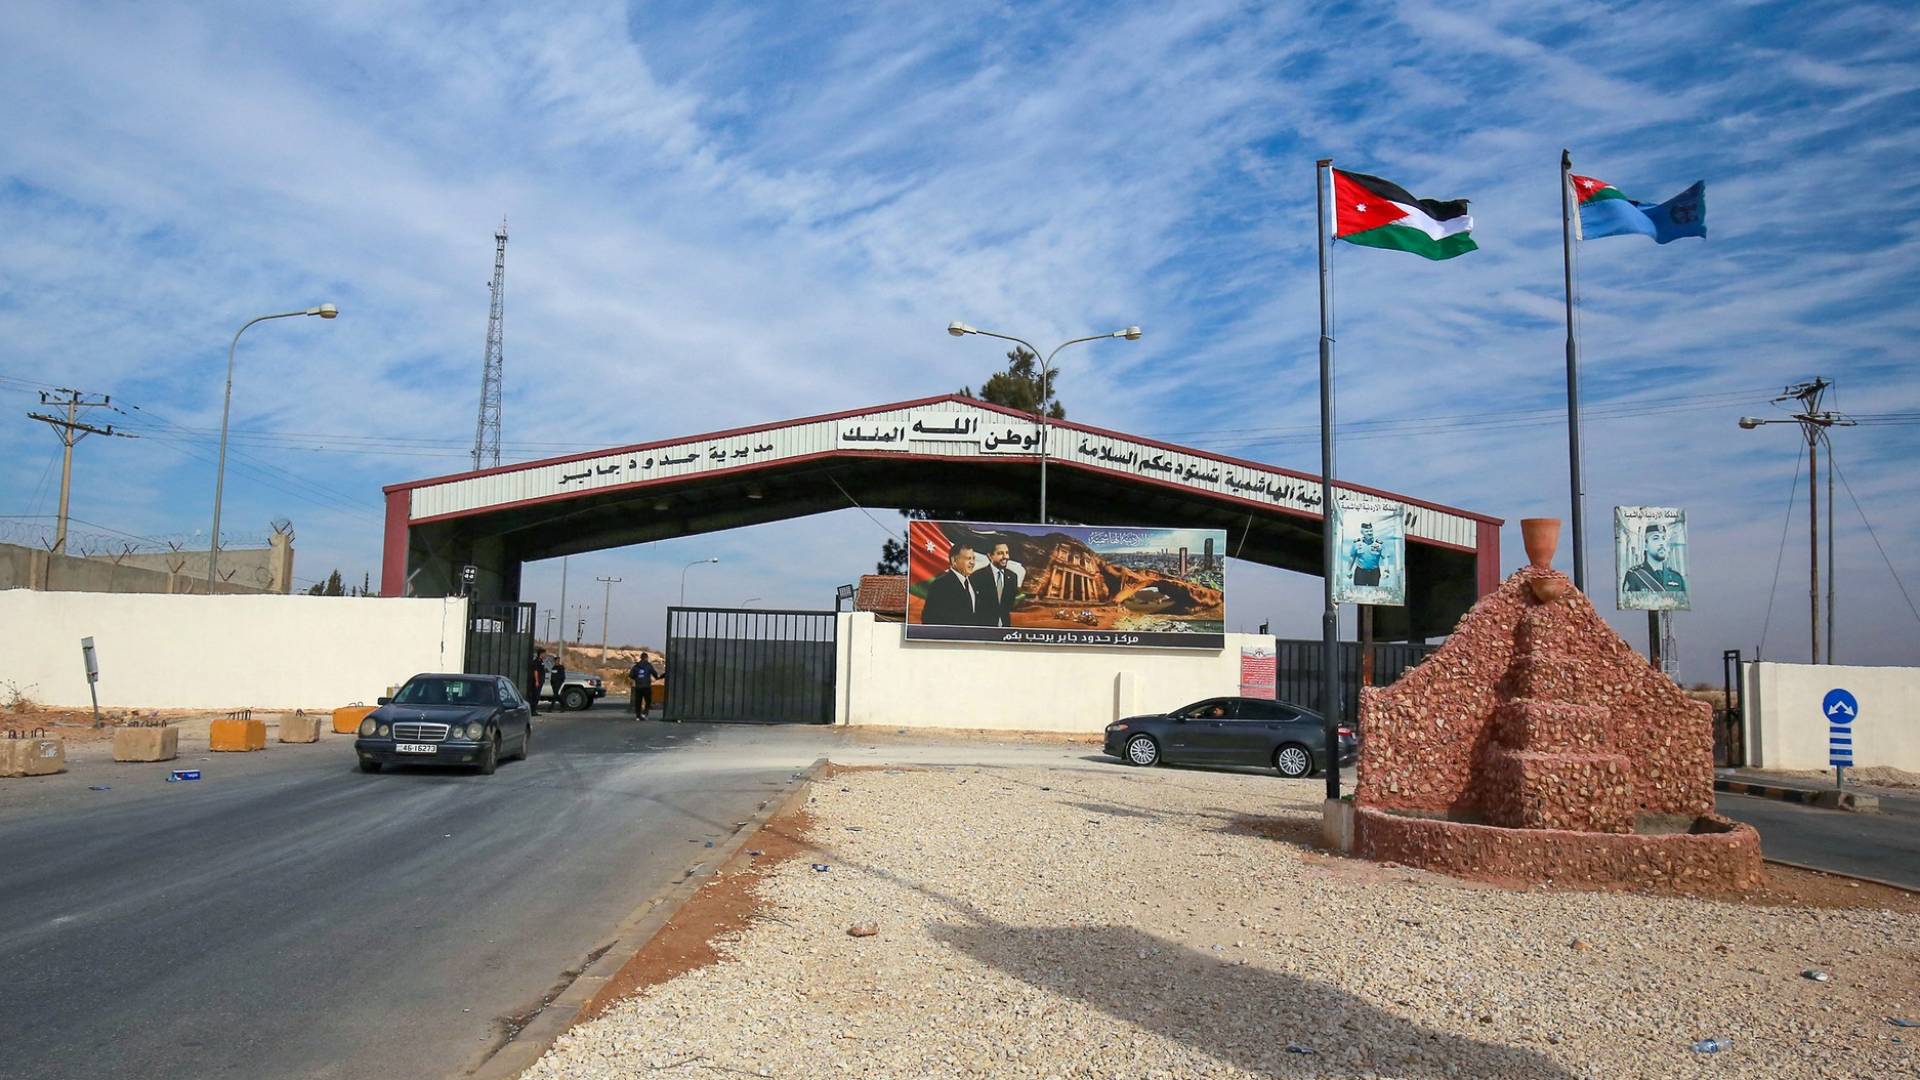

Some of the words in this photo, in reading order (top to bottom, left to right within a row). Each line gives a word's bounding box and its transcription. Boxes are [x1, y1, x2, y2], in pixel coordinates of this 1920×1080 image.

[912, 416, 978, 434] الله
[985, 428, 1047, 451] الوطن
[628, 453, 701, 470] حدود
[709, 443, 774, 463] مديرية
[1078, 438, 1138, 467] السلامة
[558, 464, 620, 485] جابر
[1137, 454, 1220, 484] تستودعكم
[1225, 470, 1295, 501] الهاشمية
[1002, 630, 1022, 642] بكم
[1025, 631, 1056, 643] يرحب
[1058, 632, 1078, 644] جابر
[1081, 634, 1111, 644] حدود
[1113, 633, 1139, 645] مركز
